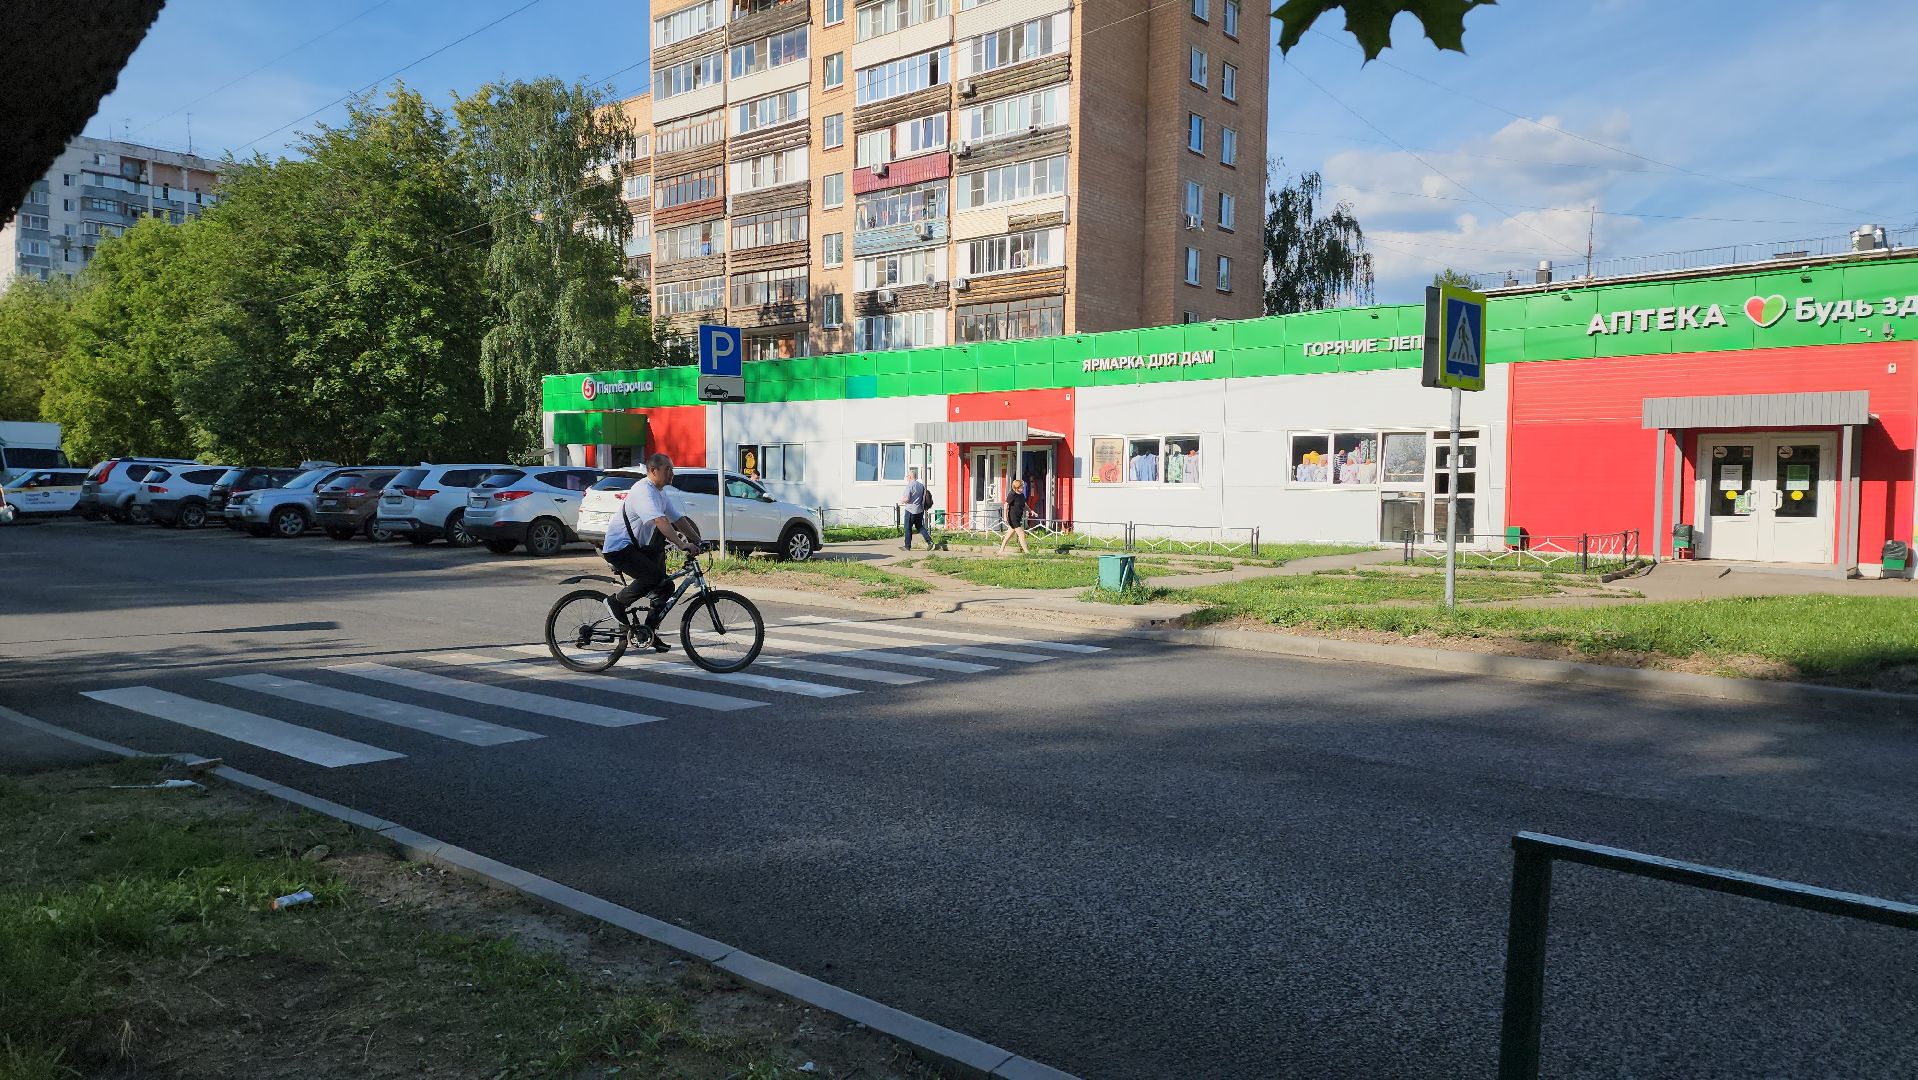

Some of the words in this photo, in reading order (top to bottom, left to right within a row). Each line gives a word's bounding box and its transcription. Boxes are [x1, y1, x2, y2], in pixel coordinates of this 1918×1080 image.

[1587, 303, 1728, 336] АПТЕКА
[1795, 296, 1875, 327] Будь
[711, 330, 735, 370] P
[1303, 338, 1378, 357] ГОРЯЧИЕ
[1388, 334, 1425, 352] ЛЕП
[1082, 355, 1145, 373] ЯРМАРКА
[1148, 352, 1178, 370] ДЛЯ
[1181, 350, 1215, 367] ДАМ
[597, 380, 653, 395] Пятёрочка
